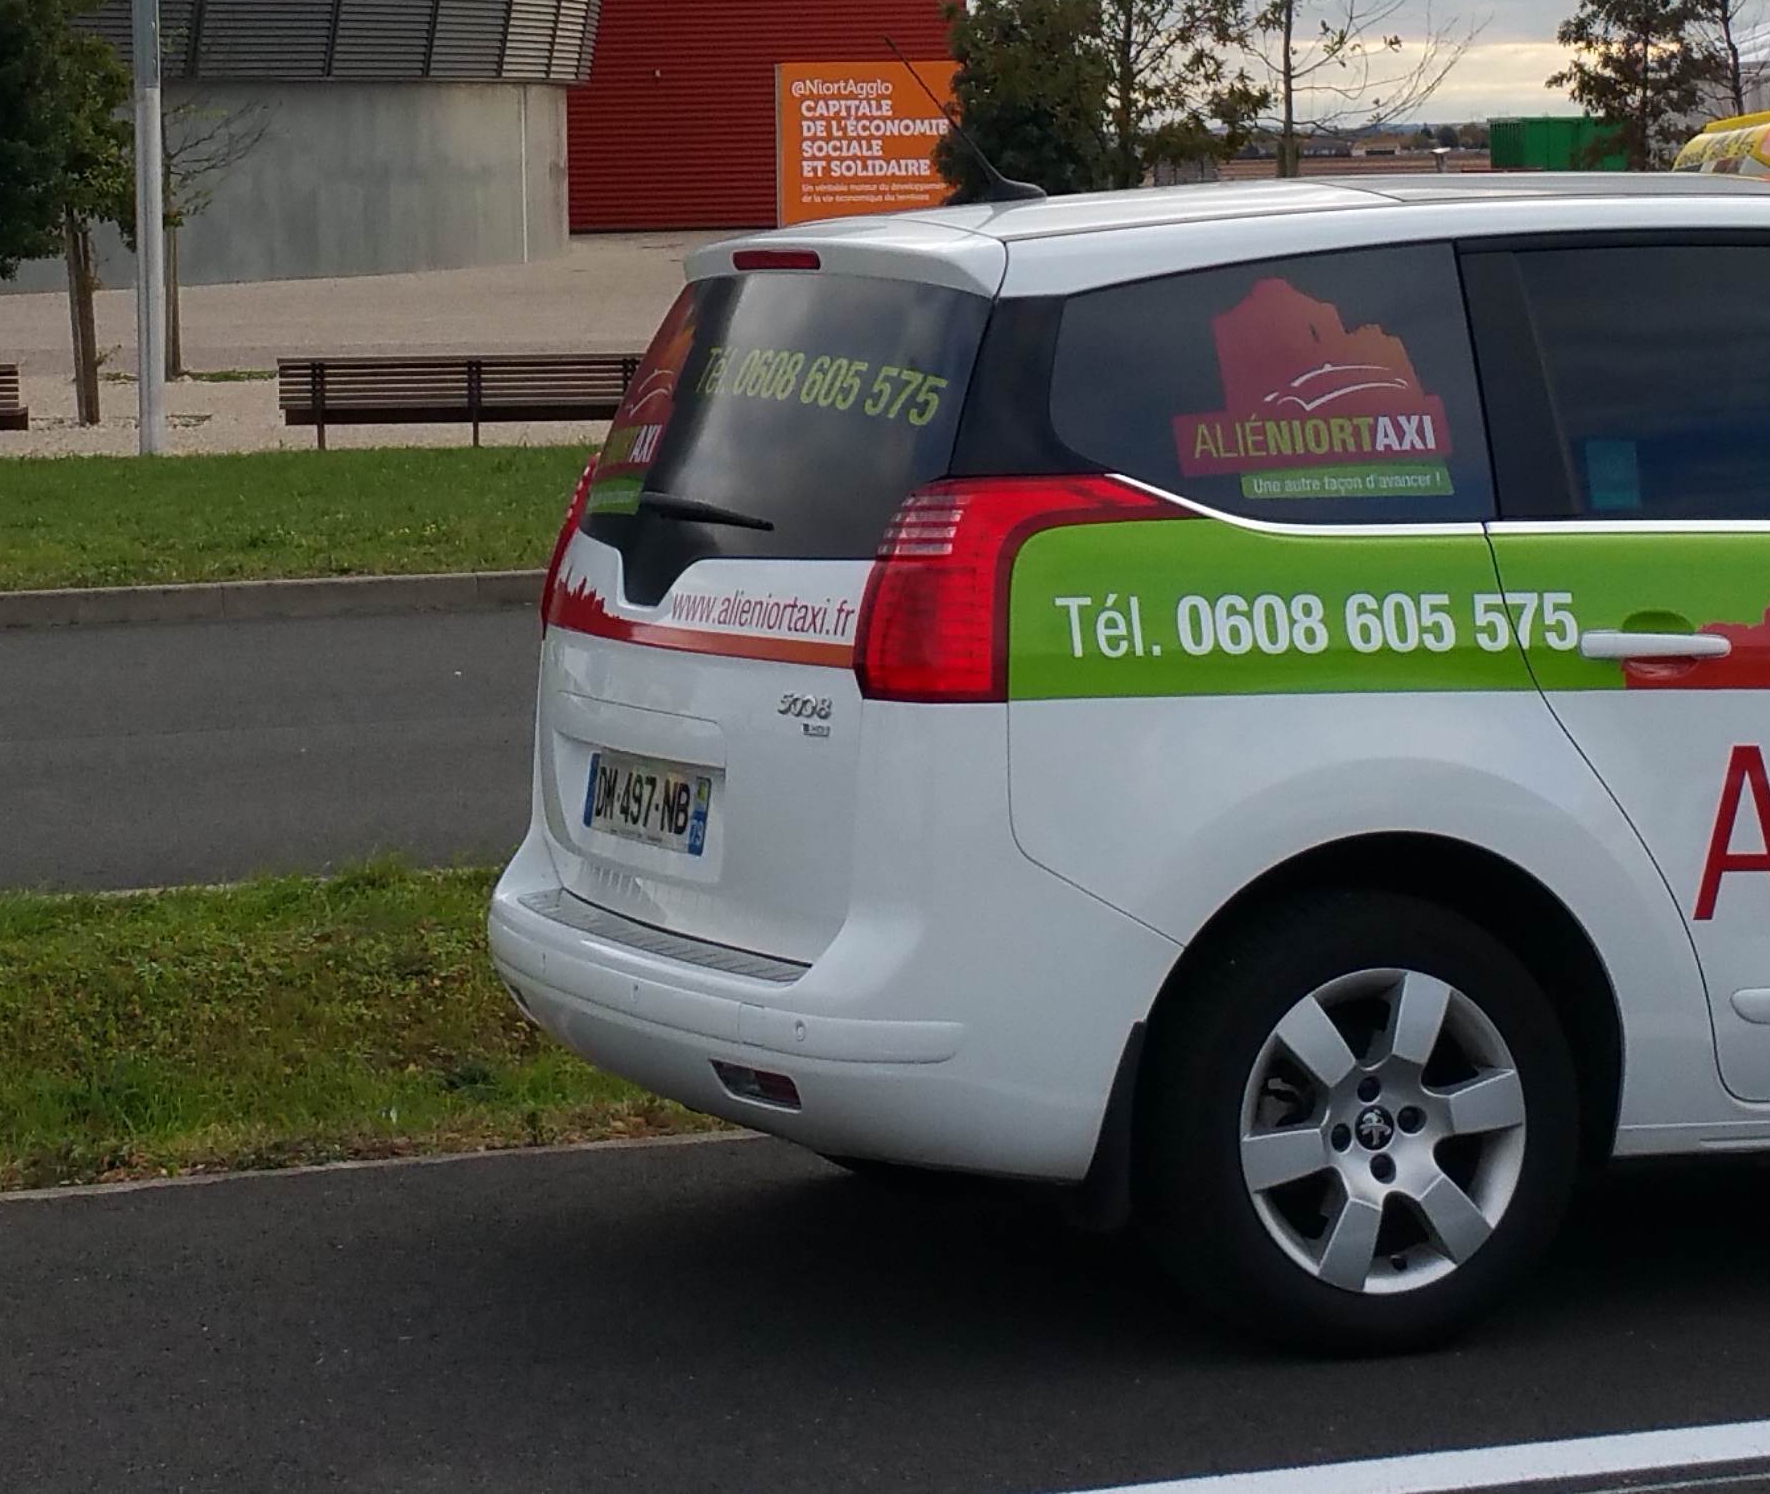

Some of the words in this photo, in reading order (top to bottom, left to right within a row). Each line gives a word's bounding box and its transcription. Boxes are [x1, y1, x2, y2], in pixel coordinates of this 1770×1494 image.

[791, 79, 893, 98] @NiortAgglo
[801, 99, 893, 118] CAPITALE
[801, 120, 827, 137] DE
[831, 115, 949, 136] L'ÉCONOMIE
[802, 139, 882, 157] SOCIALE
[801, 160, 826, 177] ET
[830, 159, 930, 177] SOLIDAIRE
[733, 349, 805, 401] 0608
[800, 355, 869, 410] 605
[865, 366, 948, 426] 575
[1194, 413, 1436, 459] ALIÉNIORTAXI
[1253, 477, 1280, 493] Une
[1284, 476, 1322, 492] autre
[1324, 475, 1363, 495] façon
[671, 589, 855, 637] www.alieniortaxi.fr
[1054, 593, 1162, 659] Tél.
[1175, 593, 1328, 657] 0608
[1345, 592, 1456, 655] 605
[1473, 592, 1579, 653] 575
[778, 693, 832, 720] 5008
